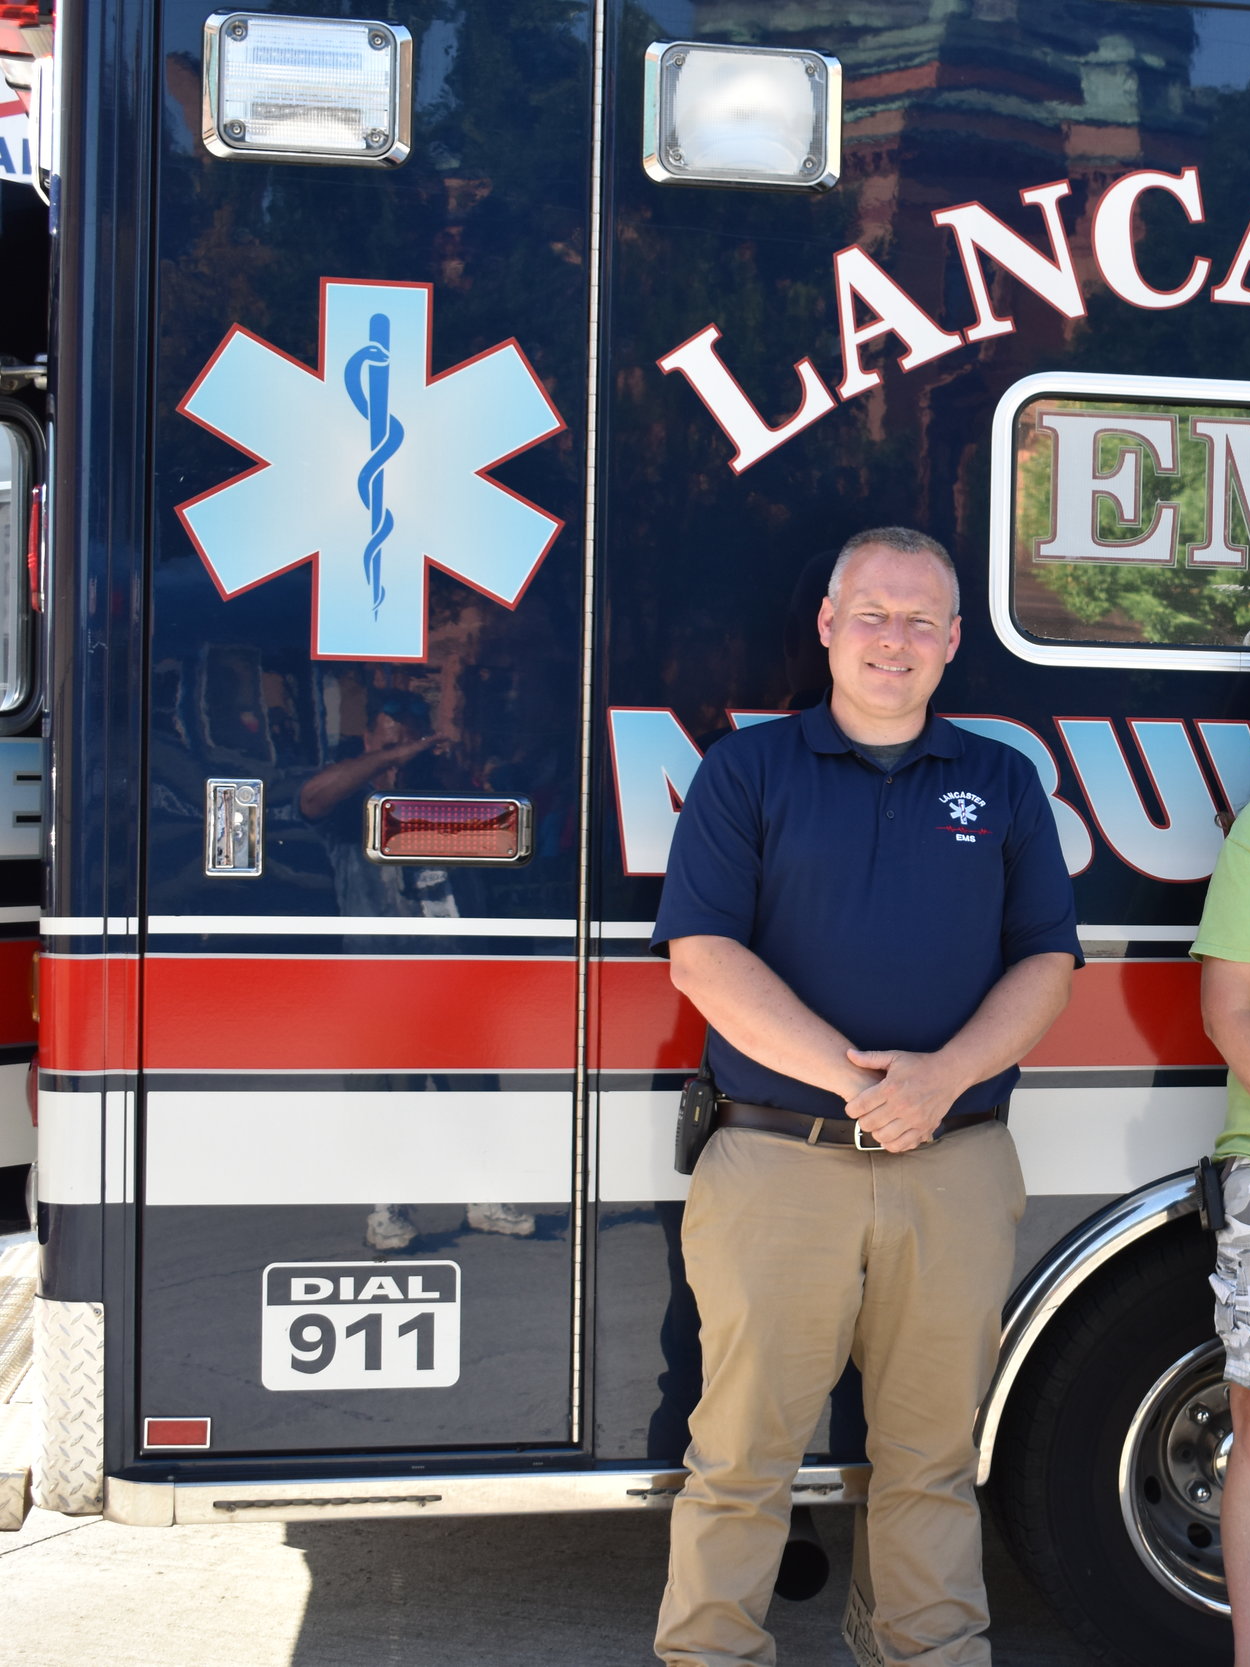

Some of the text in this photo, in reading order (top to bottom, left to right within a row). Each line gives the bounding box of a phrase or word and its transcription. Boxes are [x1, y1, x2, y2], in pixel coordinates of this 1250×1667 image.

[938, 791, 986, 807] LANCASTER
[955, 833, 976, 843] EMS
[290, 1275, 441, 1301] DIAL
[288, 1311, 436, 1375] 911
